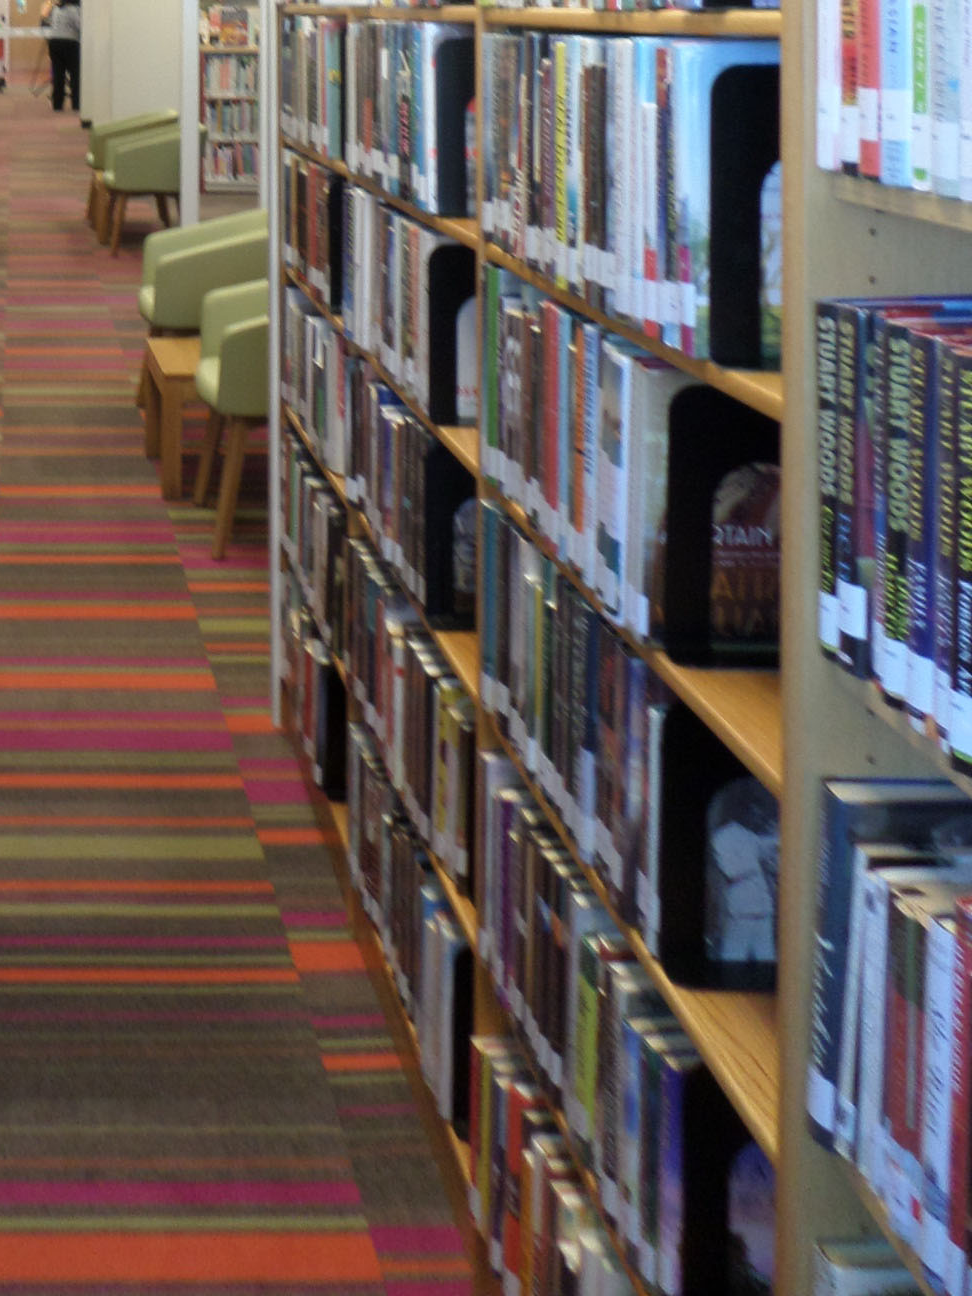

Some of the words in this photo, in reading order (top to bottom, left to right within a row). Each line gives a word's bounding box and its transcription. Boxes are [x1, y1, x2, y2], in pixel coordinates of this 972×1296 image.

[819, 317, 837, 406] STUART
[838, 321, 855, 412] STUART
[887, 336, 911, 431] STUART
[819, 409, 837, 499] WOODS
[838, 415, 855, 507] WOODS
[887, 437, 911, 532] WOODS
